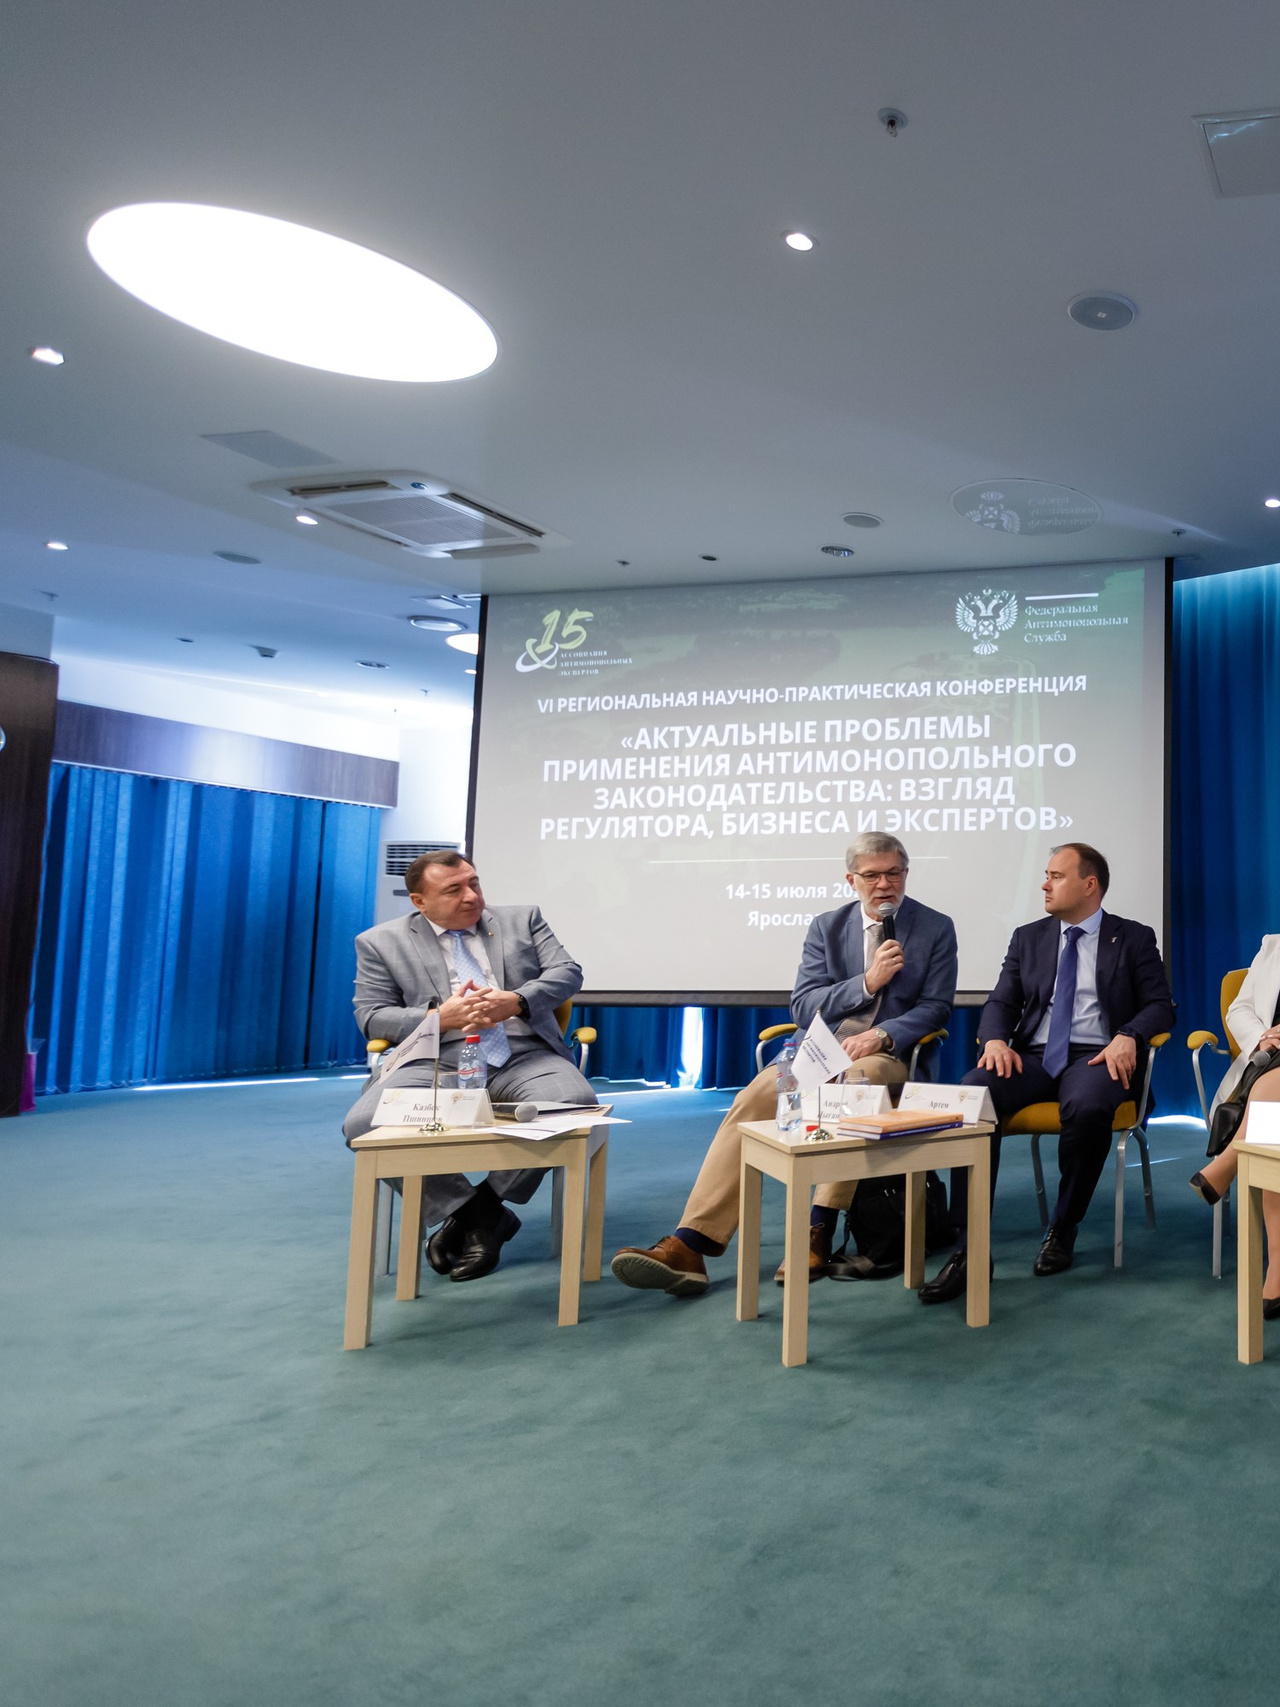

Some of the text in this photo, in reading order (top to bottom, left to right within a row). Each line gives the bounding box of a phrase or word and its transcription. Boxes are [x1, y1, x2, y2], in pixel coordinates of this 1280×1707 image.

[1024, 604, 1099, 617] Федеральная
[1024, 616, 1129, 630] Антимонопольная
[534, 608, 594, 654] 15
[1023, 630, 1067, 645] Служба
[537, 675, 1087, 713] VI РЕГИОНАЛЬНАЯ НАУЧНО-ПРАКТИЧЕСКАЯ КОНФЕРЕНЦИЯ
[620, 715, 990, 750] «АКТУАЛЬНЫЕ ПРОБЛЕМЫ
[543, 743, 1077, 782] ПРИМЕНЕНИЯ АНТИМОНОПОЛЬНОГО
[593, 776, 1015, 812] ЗАКОНОДАТЕЛЬСТВА: ВЗГЛЯД
[540, 806, 1074, 840] РЕГУЛЯТОРА, БИЗНЕСА И ЭКСПЕРТОВ»
[725, 882, 859, 899] 14-15 июля 20
[747, 910, 818, 931] Яросла
